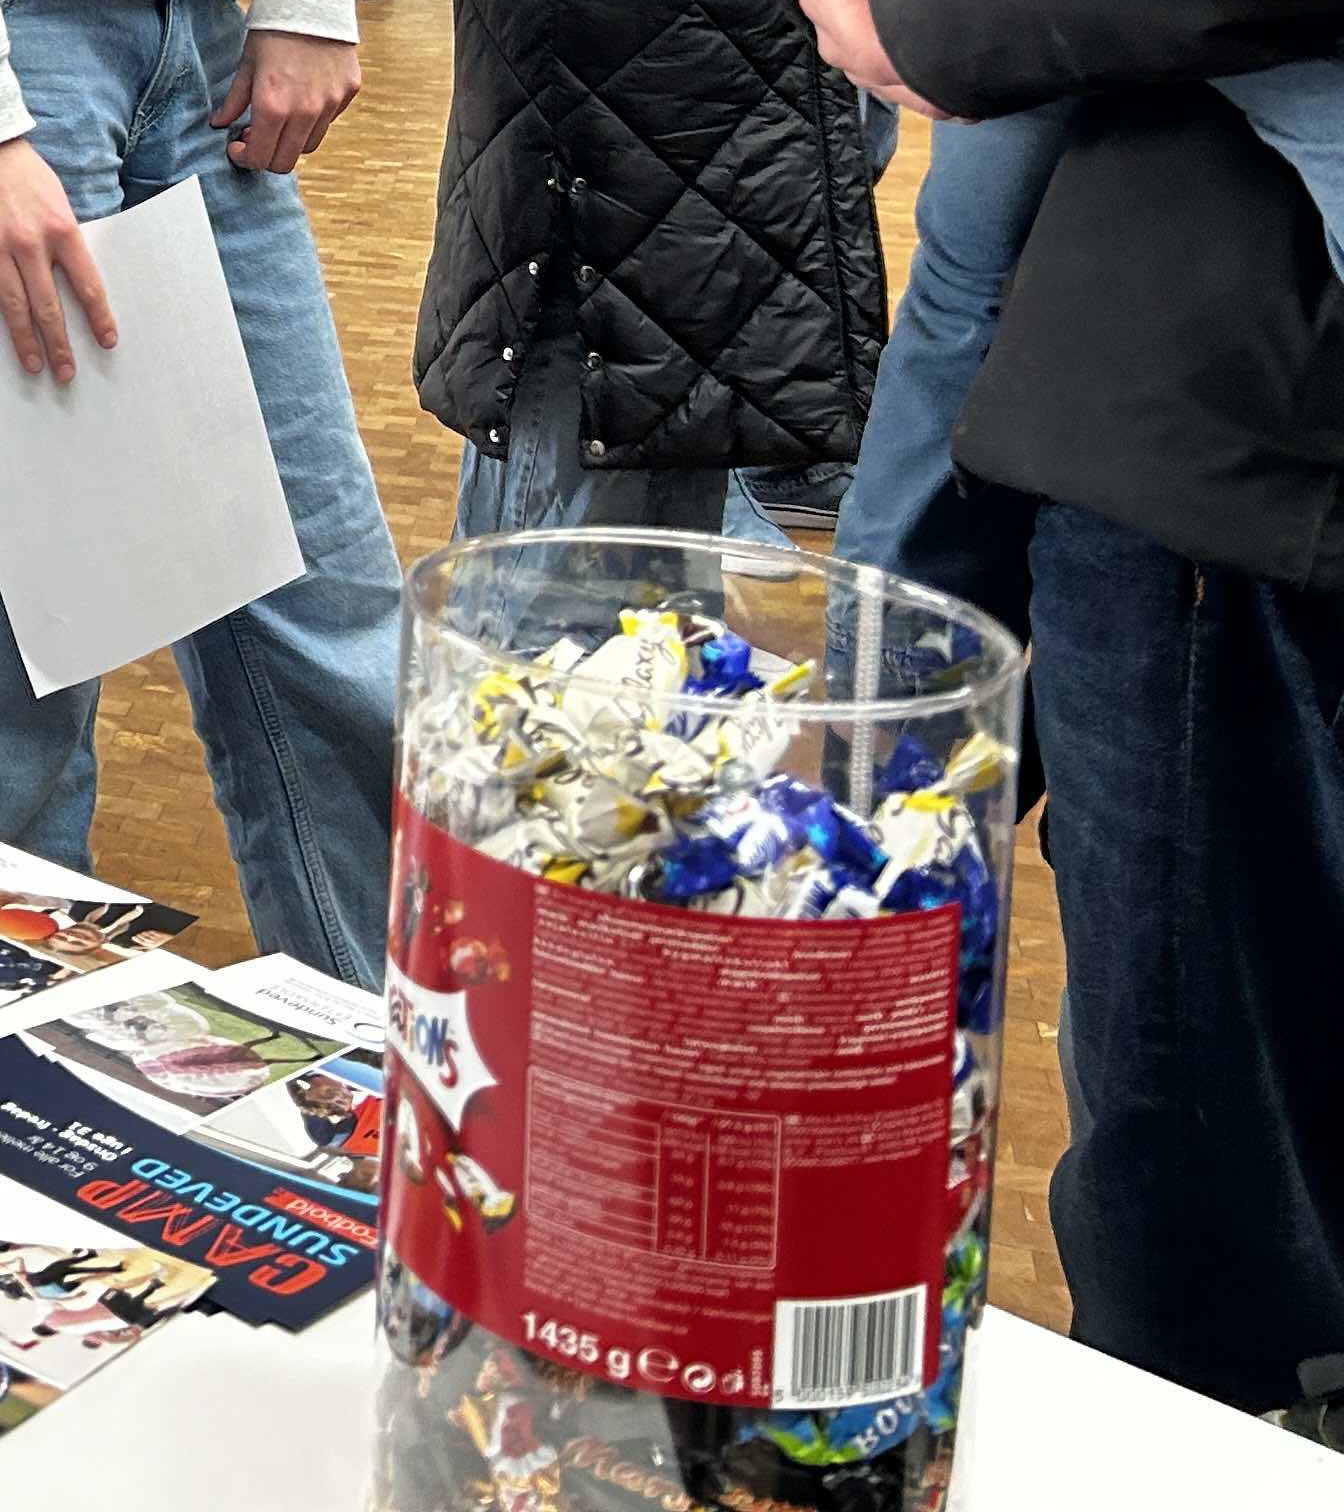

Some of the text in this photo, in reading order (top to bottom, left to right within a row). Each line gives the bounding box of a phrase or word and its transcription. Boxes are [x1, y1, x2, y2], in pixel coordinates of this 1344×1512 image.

[255, 987, 341, 1026] Sundeved
[0, 1101, 119, 1163] Onsdag fredag
[75, 1178, 328, 1296] CAMP
[130, 1157, 362, 1268] SUNDEVED
[523, 1310, 631, 1380] 1435 g
